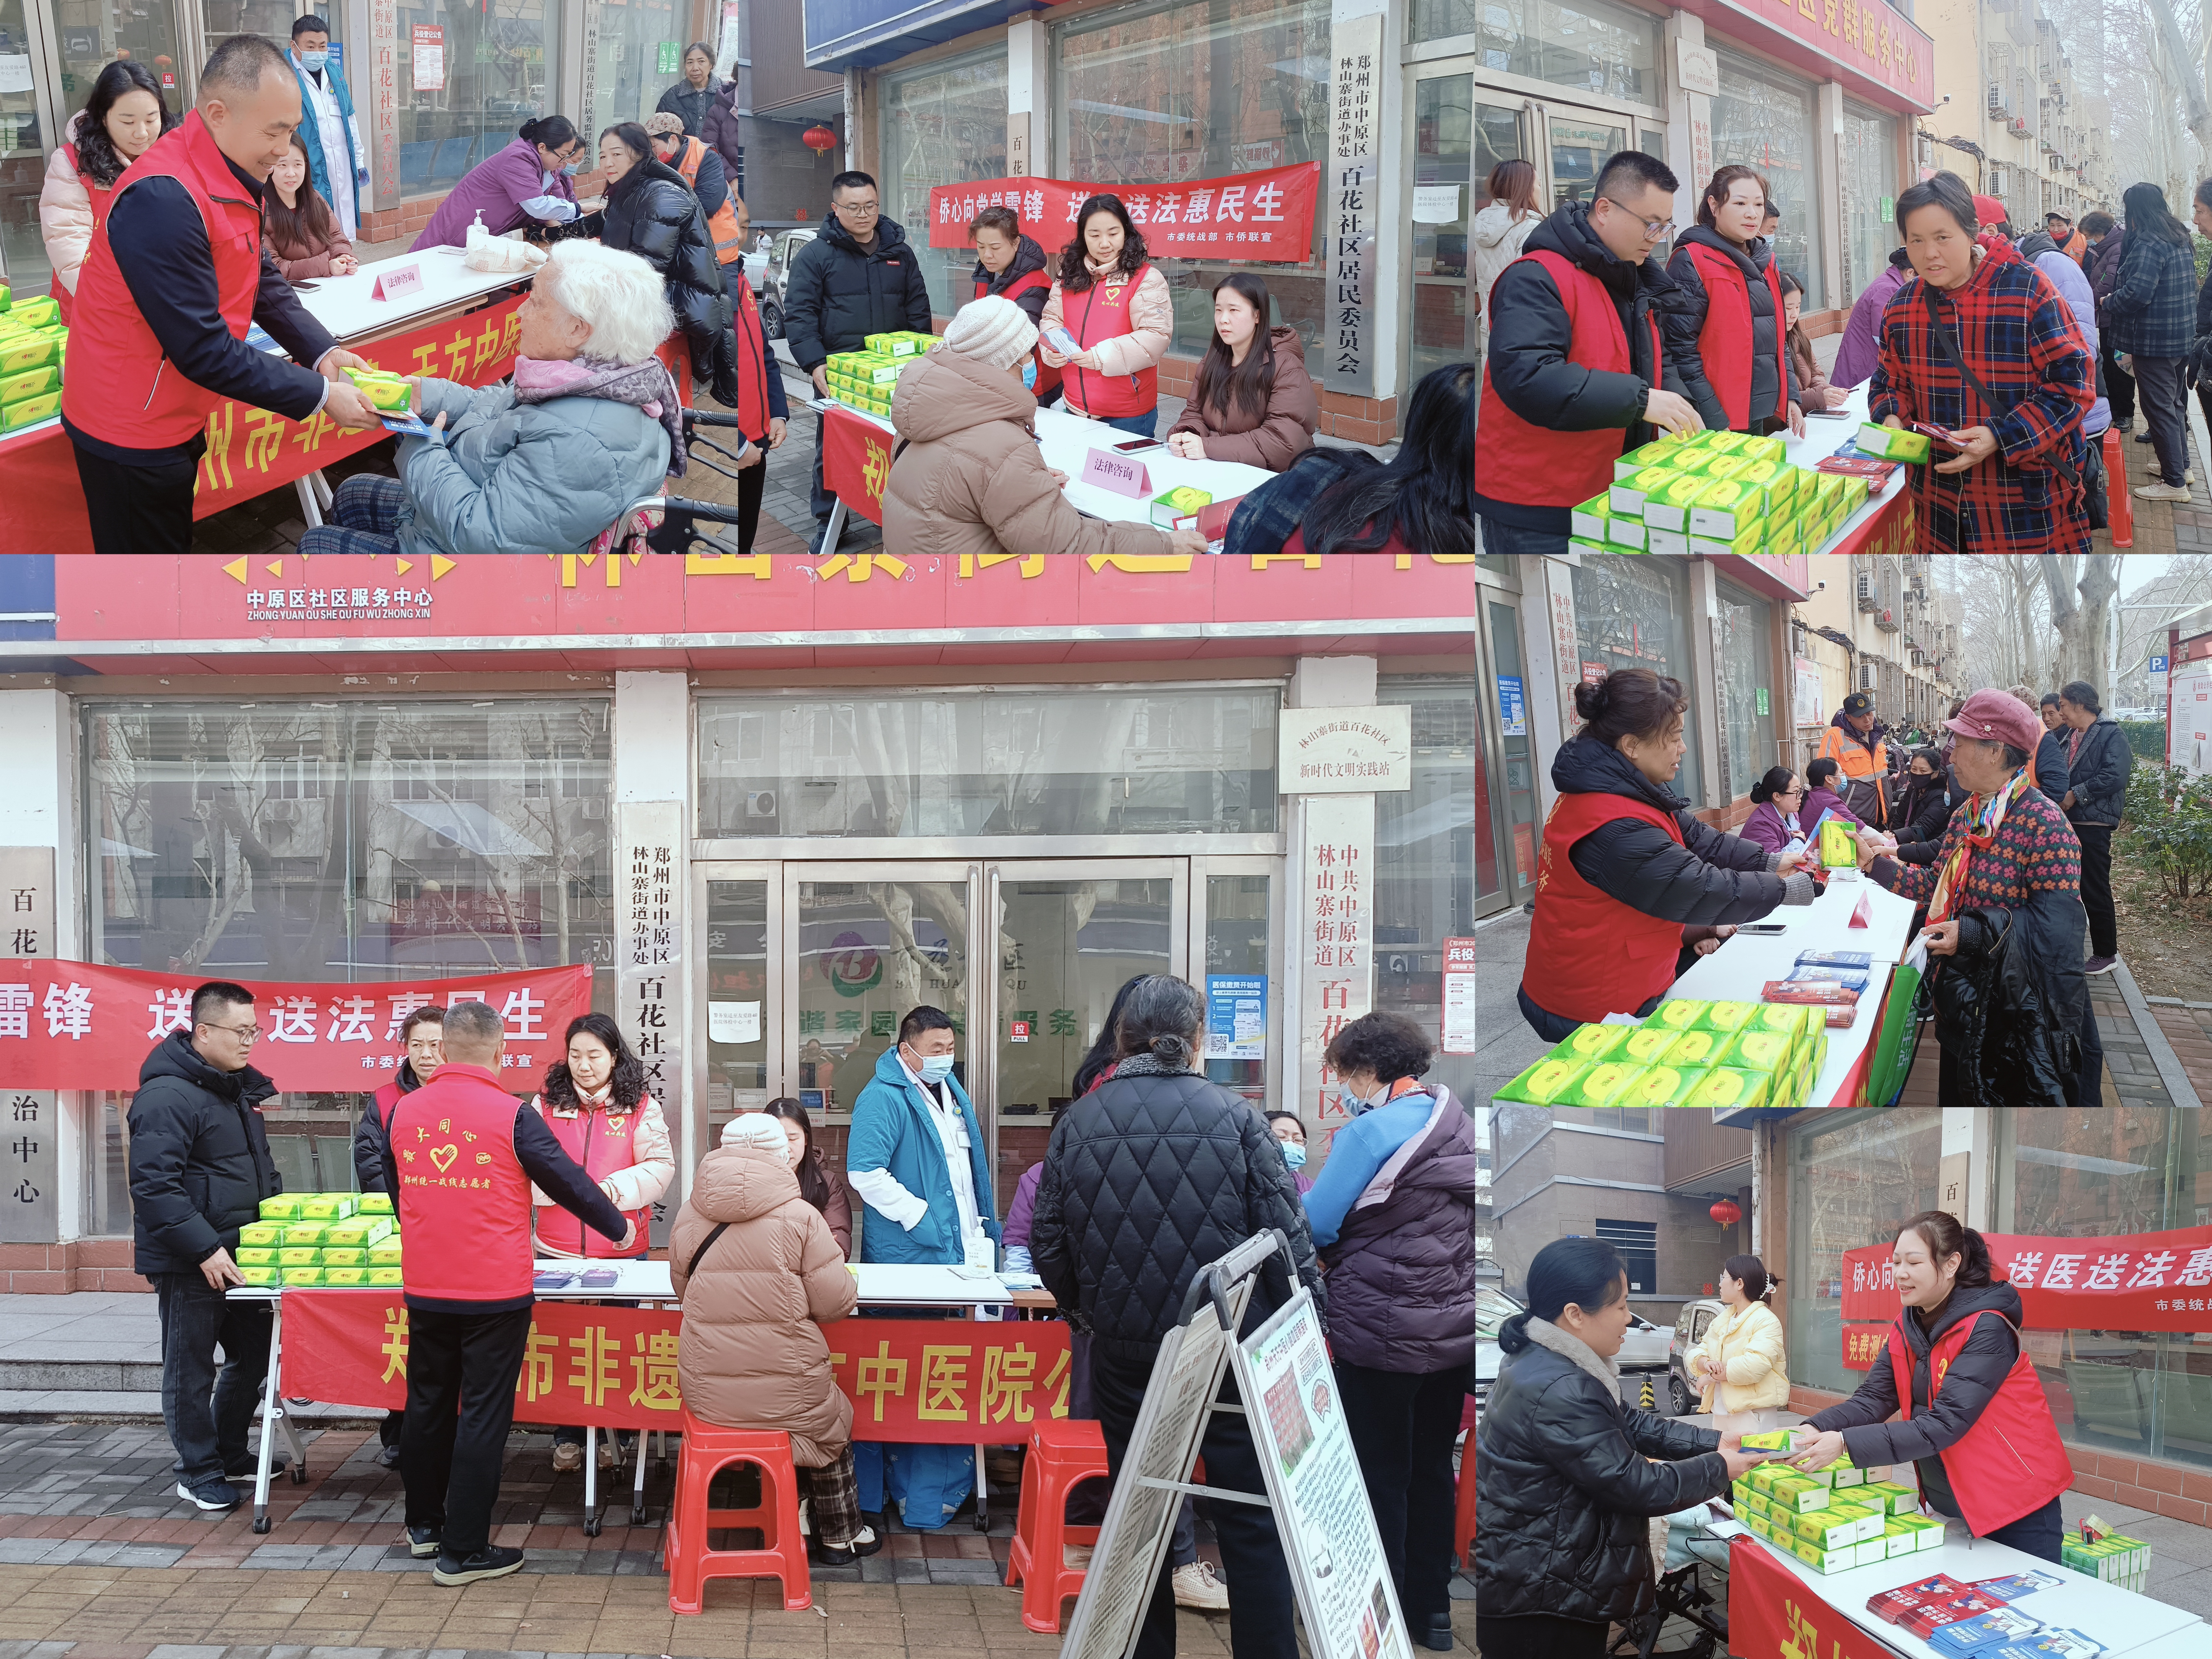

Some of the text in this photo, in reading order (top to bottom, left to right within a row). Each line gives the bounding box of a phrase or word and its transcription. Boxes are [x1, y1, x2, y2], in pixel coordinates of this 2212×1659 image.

[414, 30, 442, 39] 兵役登记公告
[1686, 72, 1713, 87] 新时代文明实践站
[378, 45, 394, 195] 百花社区委员会
[1336, 57, 1353, 158] 林山寨街道办事处
[1354, 55, 1371, 157] 郑州市中原区
[1012, 136, 1023, 175] 百花
[1695, 120, 1704, 189] 林山寨街道
[1066, 181, 1284, 224] 送送法惠民生
[1167, 231, 1272, 243] 市委统战部 市侨联宣
[388, 272, 415, 288] 法律咨询
[1336, 165, 1364, 375] 百花社区居民委员会
[1094, 458, 1133, 480] 法律咨询
[247, 587, 433, 609] 中原区社区服务中心
[1554, 592, 1569, 674] 林山寨街道
[1563, 595, 1577, 675] 中共中原区
[1584, 667, 1607, 677] 兵役登记公告
[2152, 657, 2162, 670] P
[1299, 721, 1391, 749] 林山寨街道百花社区
[1717, 674, 1730, 798] 林山寨街道百花社区居务监督委员会
[1299, 761, 1389, 778] 新时代文明实践站
[10, 887, 38, 956] 百花
[631, 845, 649, 966] 林山寨街道办事处
[652, 845, 671, 966] 郑州市中原区
[1314, 844, 1336, 967] 林山寨街道
[1338, 844, 1359, 968] 中共中原区
[1447, 948, 1475, 961] 兵役
[1212, 980, 1261, 990] 医保缴费开始啦
[1015, 1024, 1025, 1034] 拉
[11, 1095, 41, 1205] 治中心
[404, 1175, 490, 1189] 郑州统一战线志愿者
[2007, 1245, 2212, 1290] 送医送法惠
